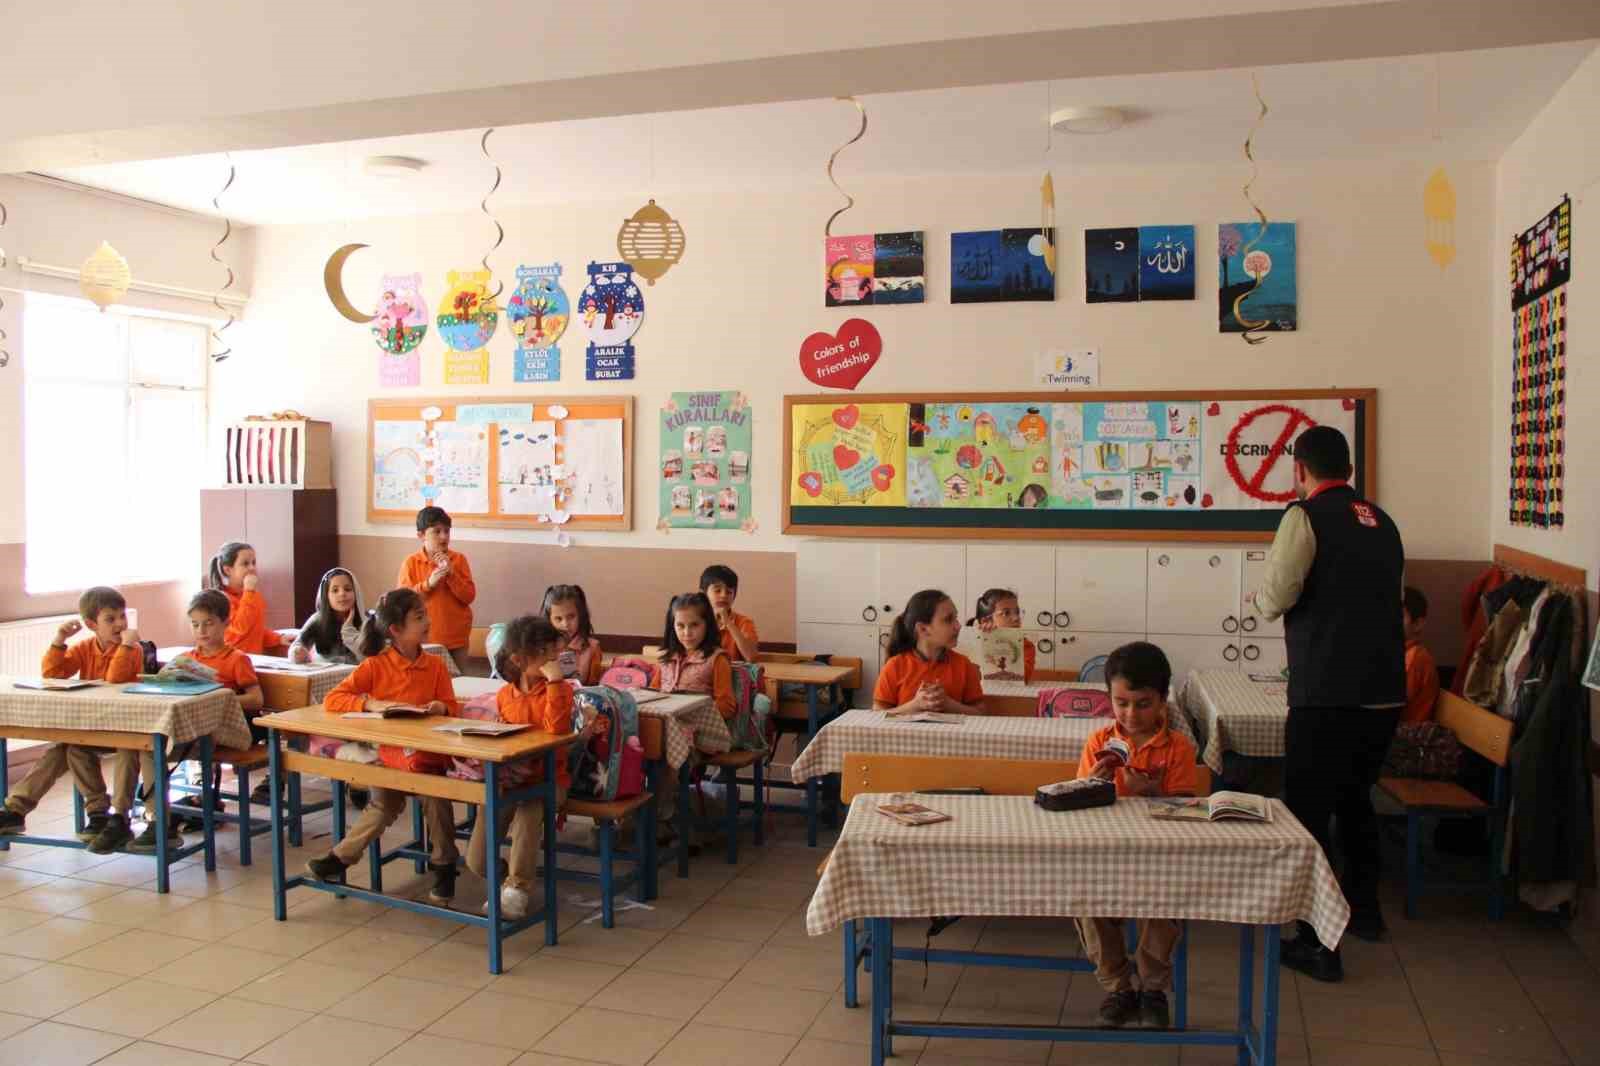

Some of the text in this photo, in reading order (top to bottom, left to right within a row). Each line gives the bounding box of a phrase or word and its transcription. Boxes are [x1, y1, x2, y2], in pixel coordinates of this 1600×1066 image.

[814, 335, 860, 360] Colors of
[596, 358, 620, 367] OCAK
[816, 352, 870, 378] friendship
[688, 392, 721, 408] SINIF
[665, 407, 746, 432] KURALLARI
